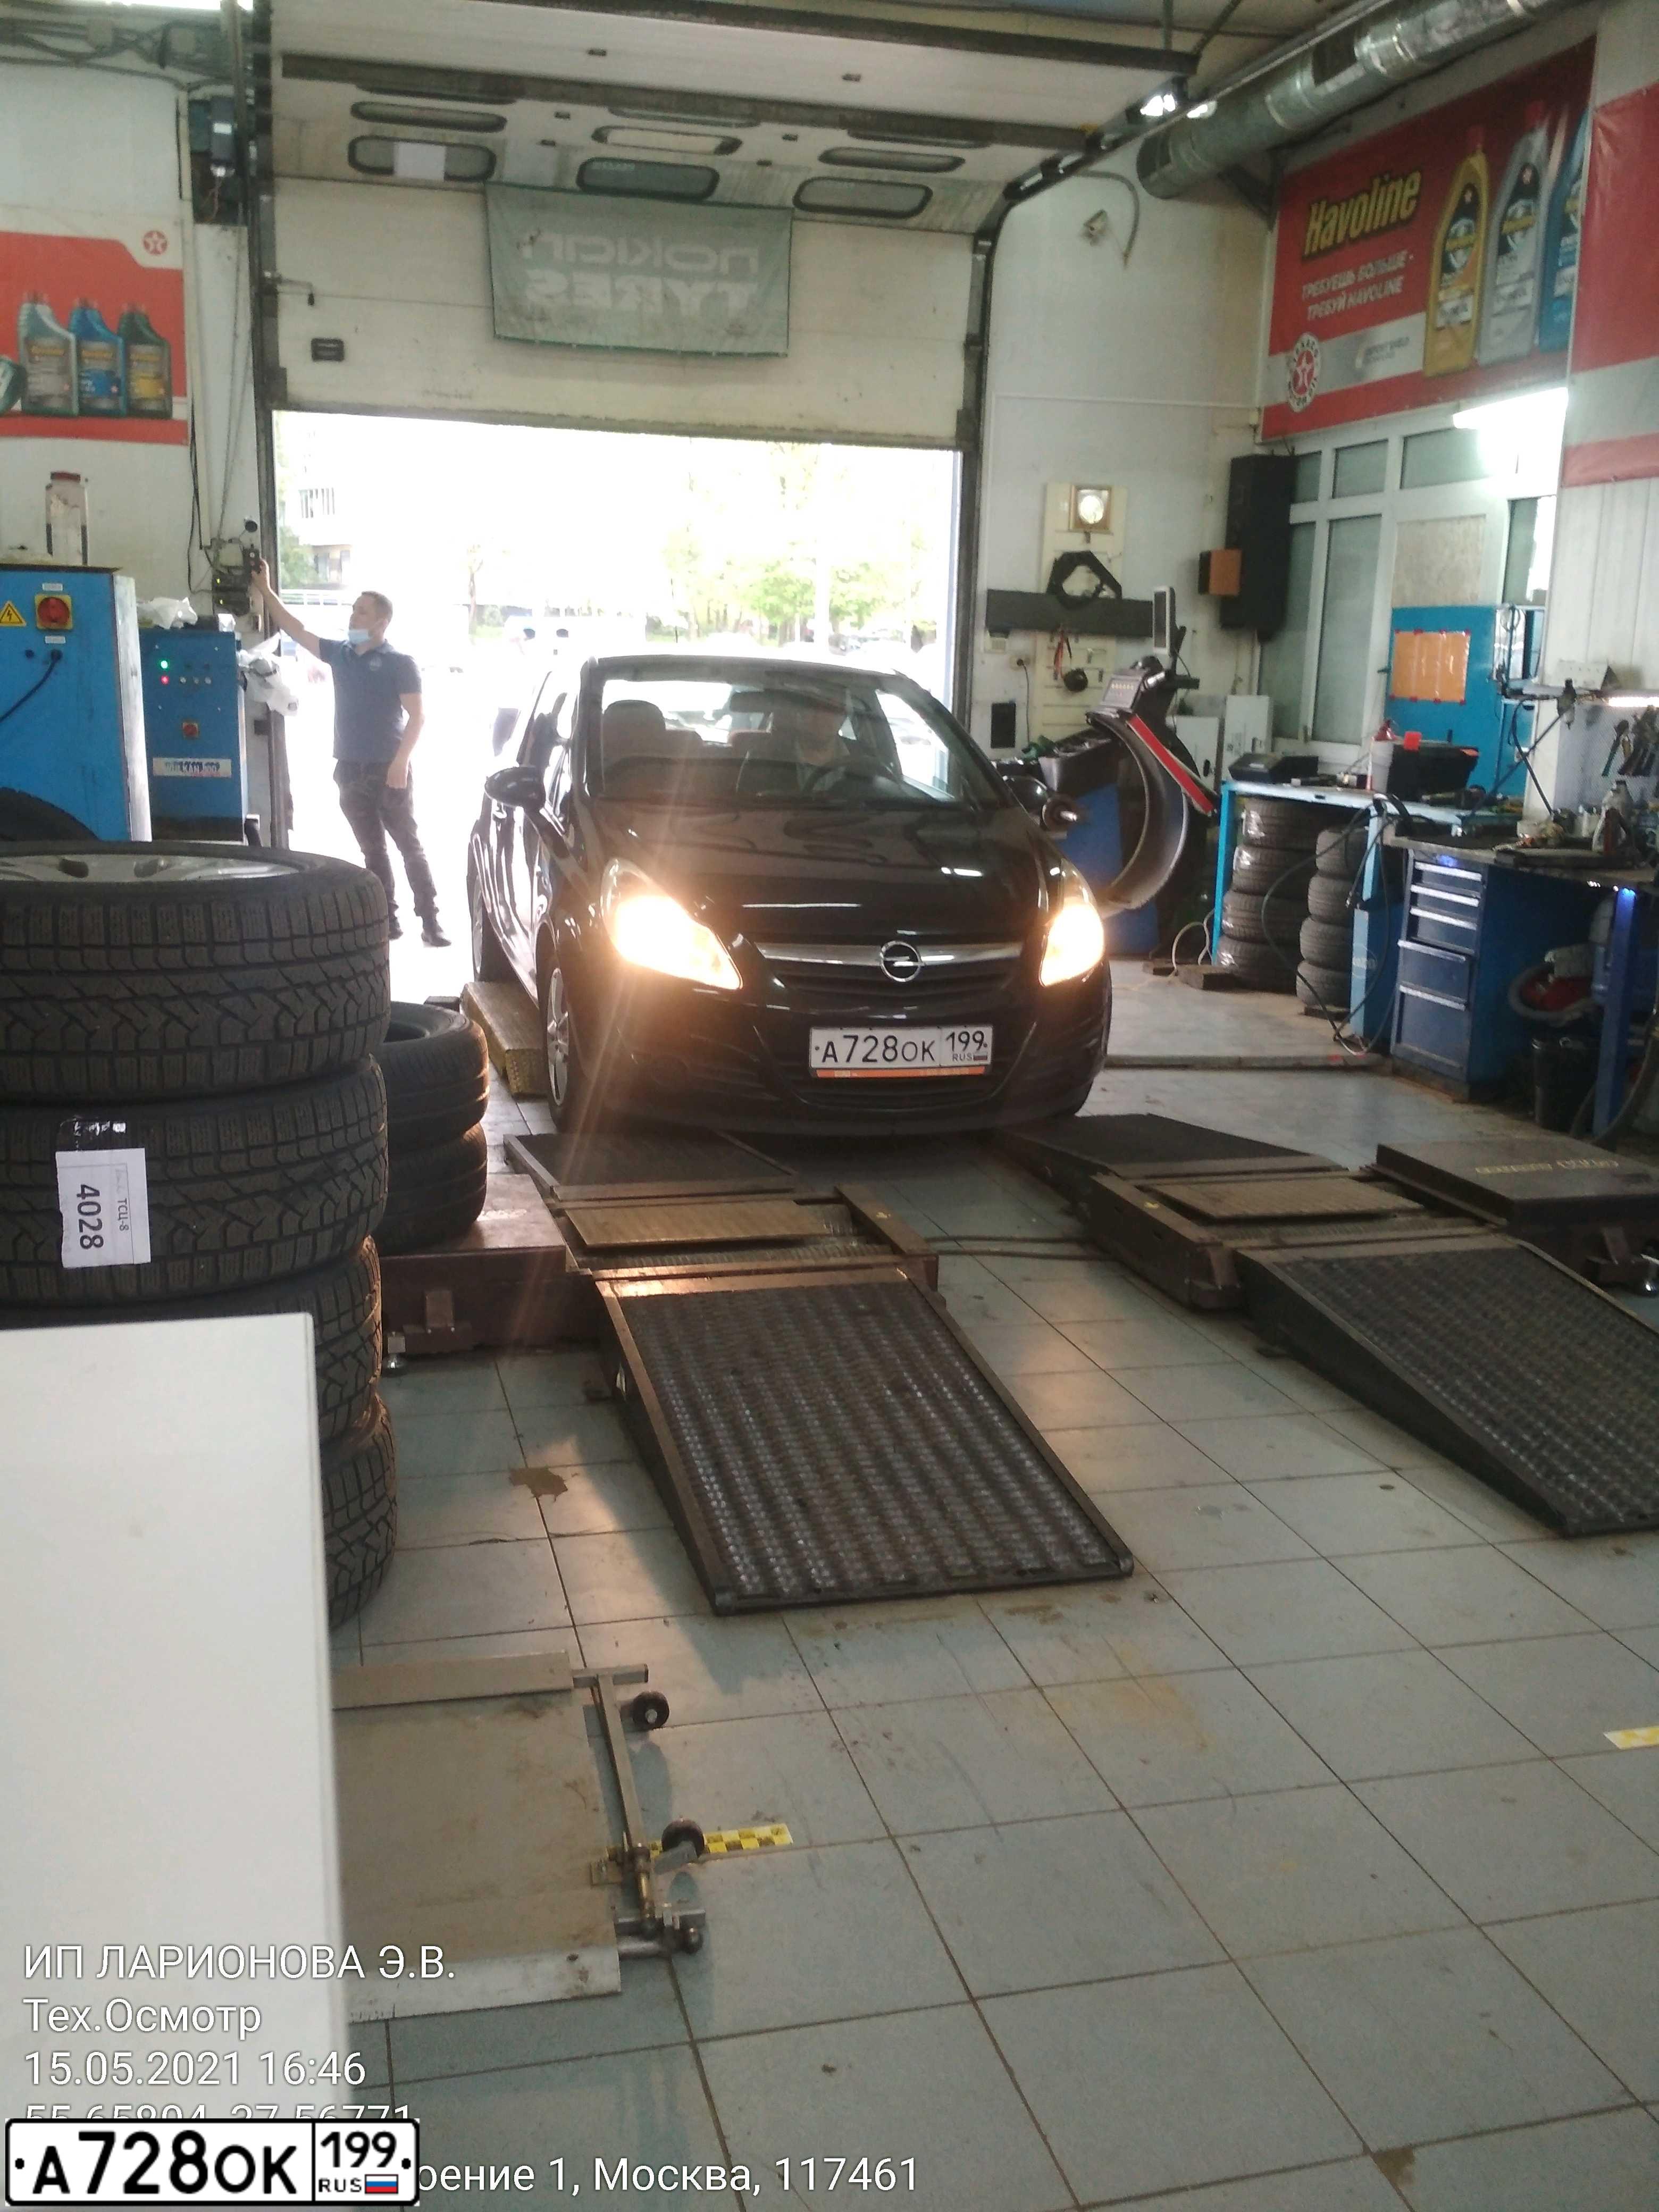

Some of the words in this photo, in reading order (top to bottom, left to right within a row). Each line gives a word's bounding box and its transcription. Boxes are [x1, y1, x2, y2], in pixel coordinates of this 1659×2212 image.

[1304, 171, 1421, 255] Havoline
[822, 1034, 935, 1063] А728ОК
[945, 1030, 985, 1052] 199
[952, 1053, 973, 1062] RUS
[76, 1184, 104, 1250] 4028
